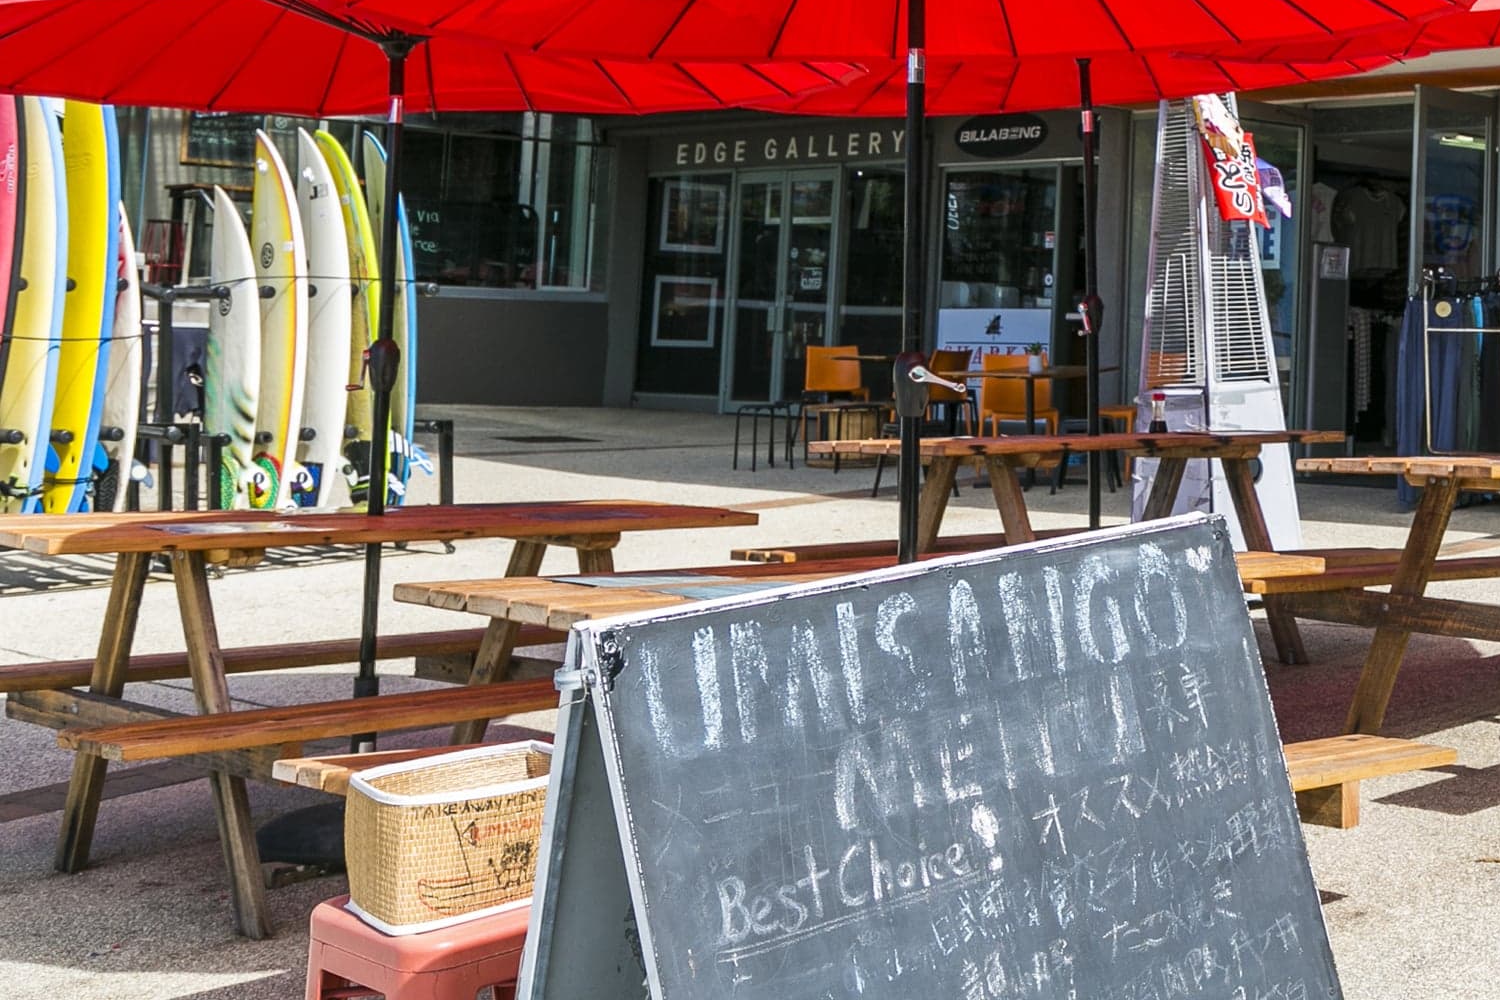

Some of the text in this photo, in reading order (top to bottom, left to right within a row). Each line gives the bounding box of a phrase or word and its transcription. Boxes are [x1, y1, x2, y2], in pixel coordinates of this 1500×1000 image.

[676, 130, 904, 165] EDGE GALLERY
[639, 541, 1188, 760] UMISANGO
[712, 844, 830, 946] Best
